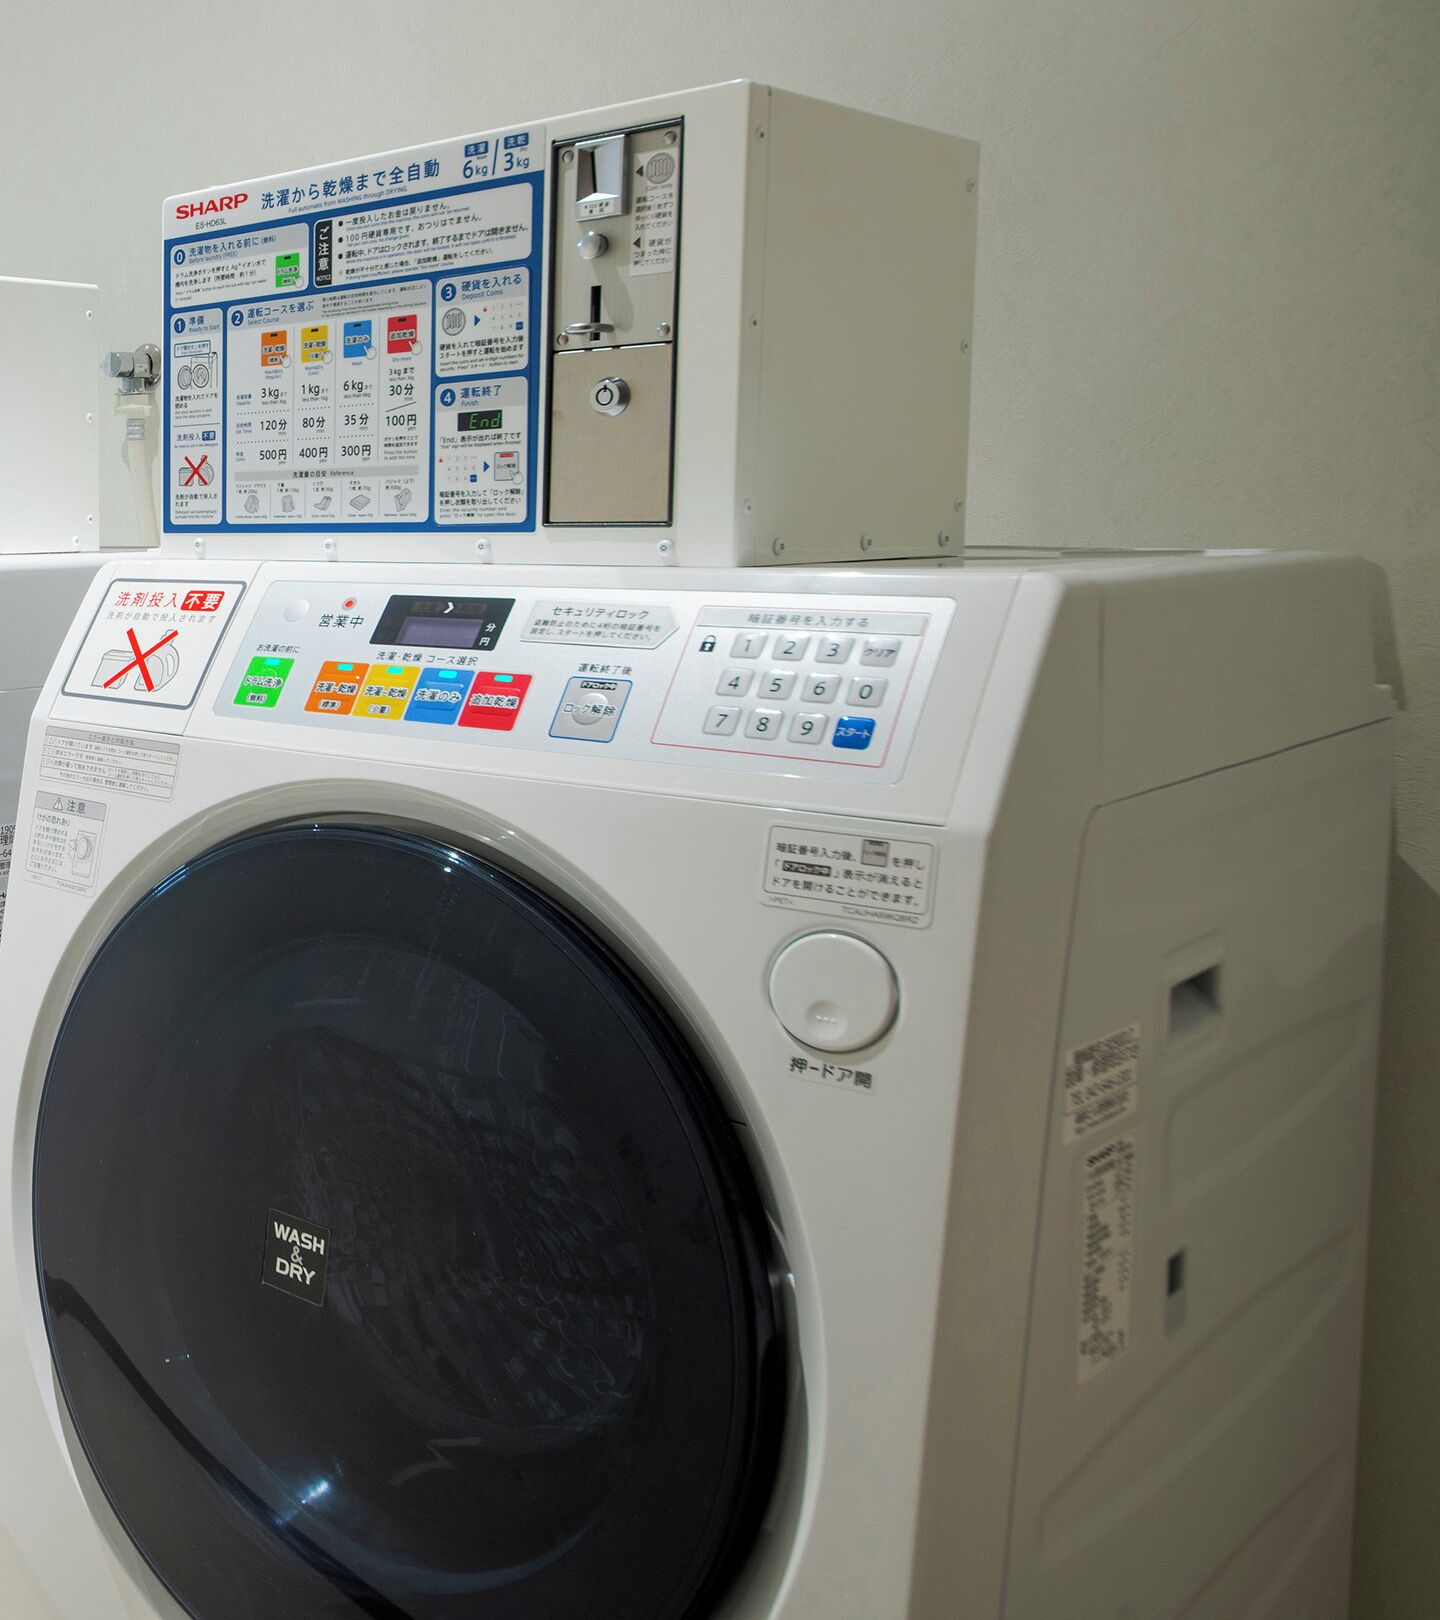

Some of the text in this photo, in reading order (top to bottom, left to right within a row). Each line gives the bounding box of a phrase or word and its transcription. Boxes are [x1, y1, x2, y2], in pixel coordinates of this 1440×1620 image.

[261, 159, 440, 210] 洗濯から乾燥まで全自動
[176, 193, 249, 219] SHARP
[317, 225, 330, 272] ご注意
[445, 273, 522, 299] 3 硬貨を入れる
[188, 315, 205, 326] 準備
[234, 301, 314, 324] 2 運転コースを選ぶ
[444, 385, 501, 404] 4 運転終了
[260, 418, 287, 431] 120分
[302, 416, 325, 429] 80分
[344, 413, 369, 426] 35分
[386, 414, 417, 426] 100円
[469, 412, 501, 430] End
[260, 449, 287, 460] 500円
[299, 447, 328, 458] 400円
[341, 444, 371, 457] 300円
[114, 590, 222, 611] 洗剤投入 不要
[553, 606, 649, 620] セキュリティロック
[747, 612, 870, 629] 暗証番号を入力する
[318, 613, 365, 630] 営業中
[256, 644, 301, 654] お洗濯の前に
[479, 637, 491, 647] 円
[783, 641, 797, 655] 2
[826, 642, 840, 657] 3
[863, 648, 897, 659] クリア
[426, 655, 479, 666] コース選択
[578, 663, 633, 676] 運転終了後
[416, 689, 461, 702] 洗濯のみ
[727, 676, 873, 699] 4 5 6 0
[471, 694, 519, 708] 追加乾燥
[563, 703, 617, 717] ロック解除
[716, 714, 872, 739] 7 8 9 スタート
[66, 799, 86, 814] 注意
[772, 877, 920, 907] ドアを開けることができます。
[274, 1221, 325, 1255] WASH
[290, 1245, 303, 1265] &
[275, 1257, 316, 1285] DRY
